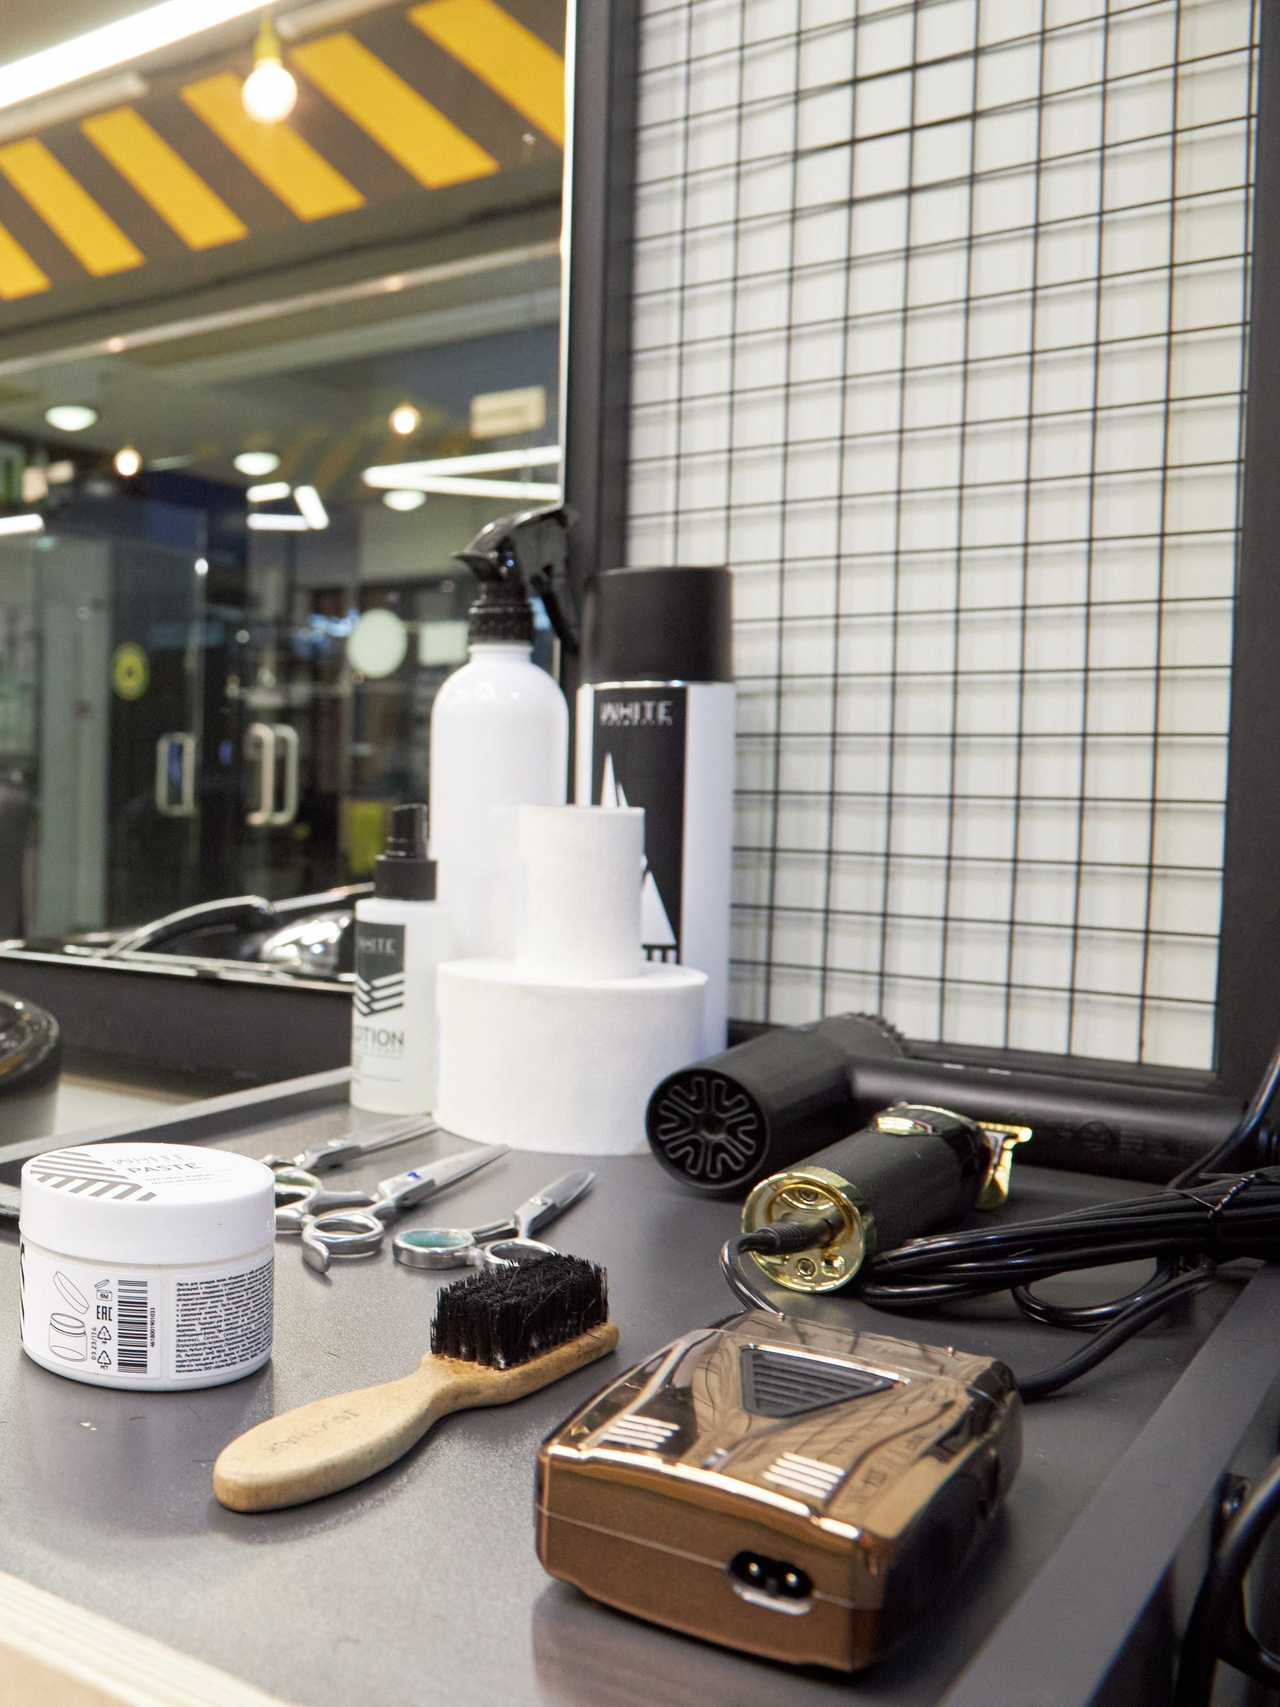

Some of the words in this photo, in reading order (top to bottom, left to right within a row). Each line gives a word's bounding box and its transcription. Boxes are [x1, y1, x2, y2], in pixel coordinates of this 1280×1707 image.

[600, 700, 673, 721] WHITE
[128, 1162, 203, 1174] PASTE
[96, 1305, 113, 1322] EAC
